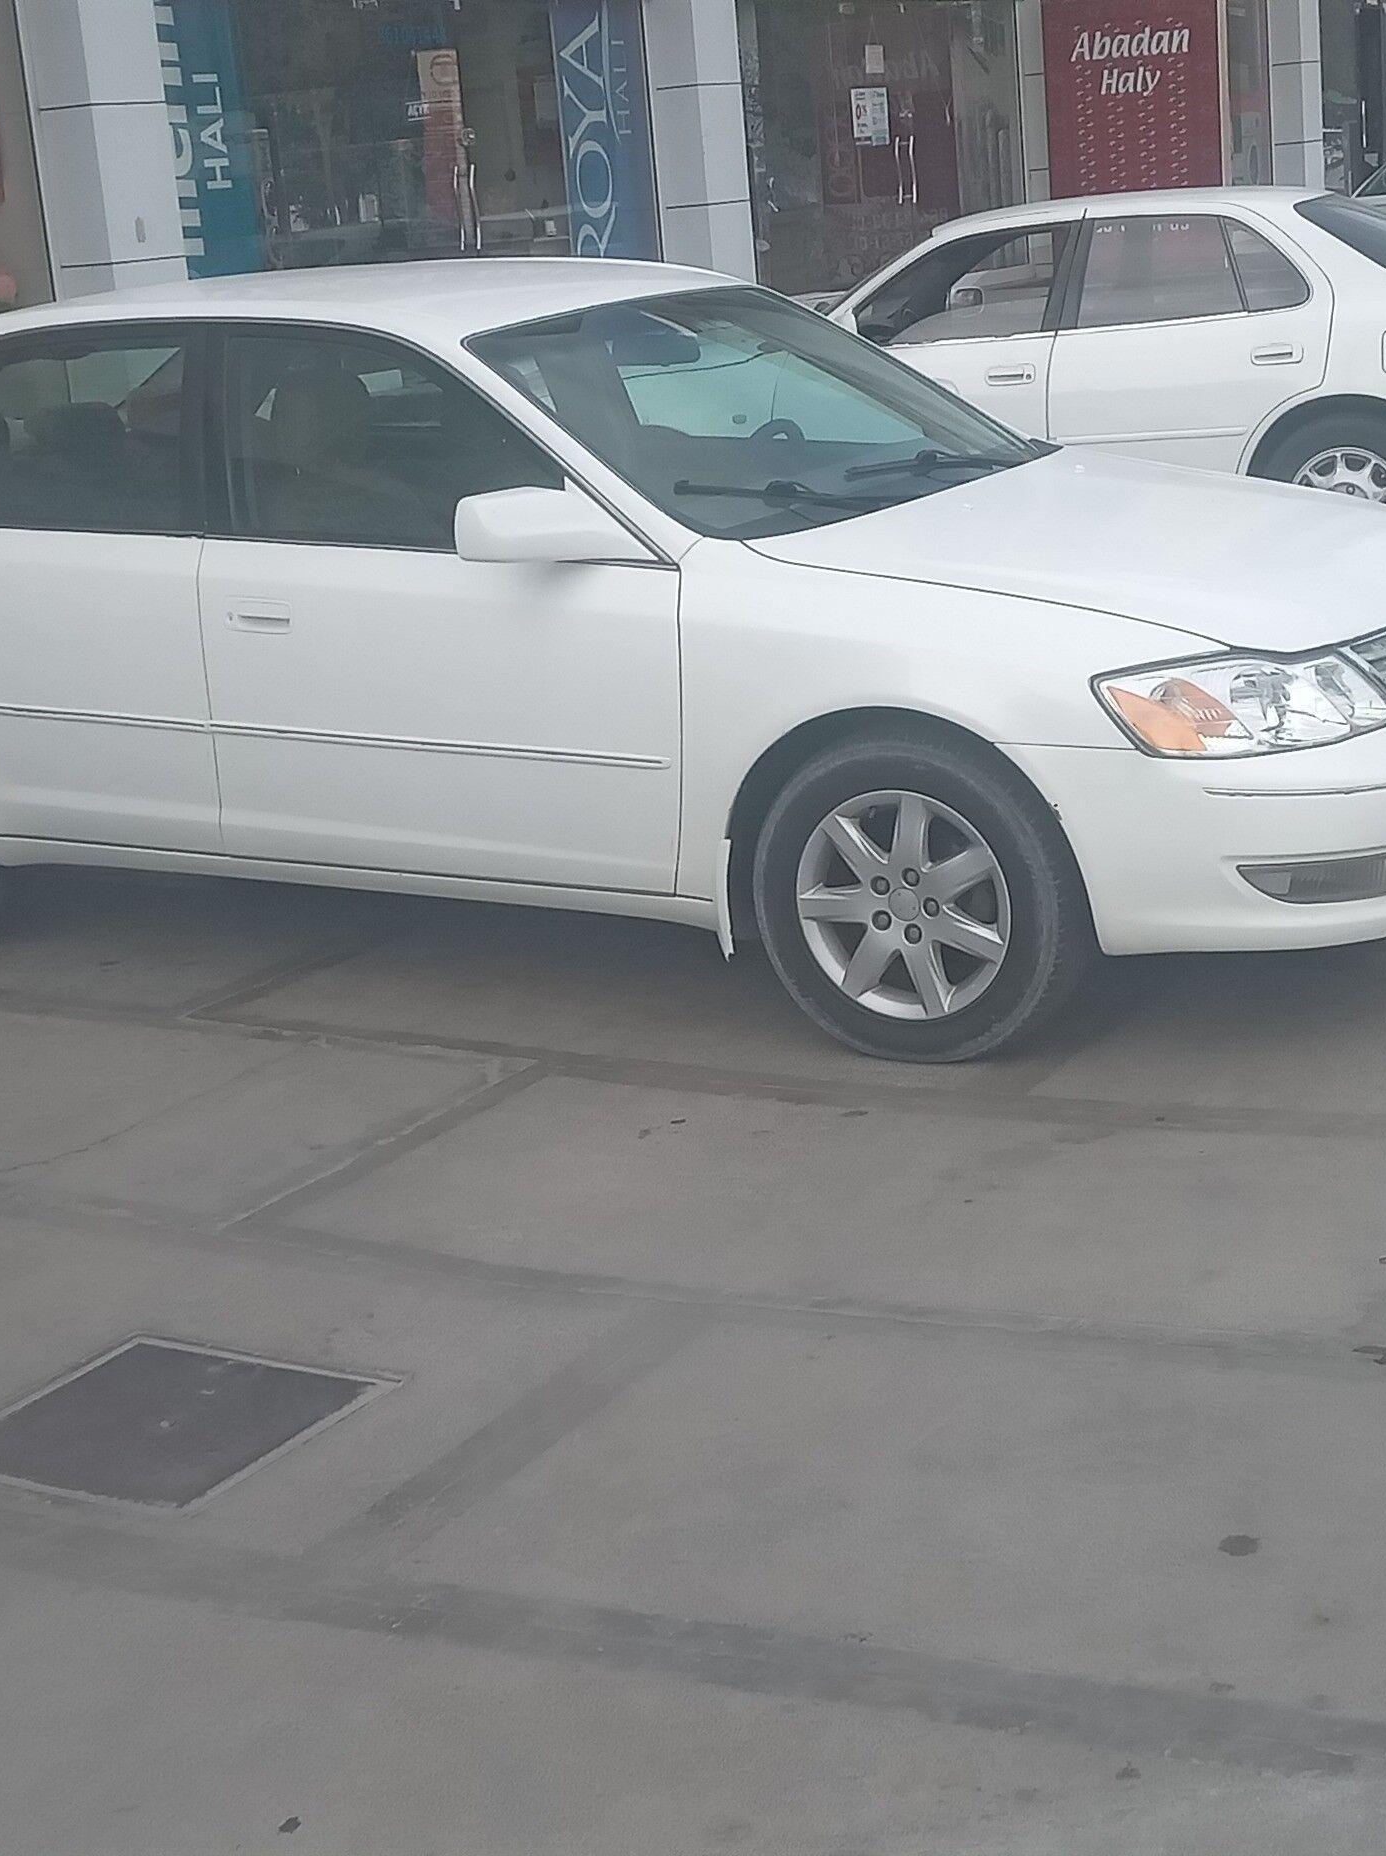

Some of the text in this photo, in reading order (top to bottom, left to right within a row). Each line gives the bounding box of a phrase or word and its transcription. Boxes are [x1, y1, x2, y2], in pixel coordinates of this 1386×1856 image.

[611, 40, 632, 135] HALI
[1070, 26, 1191, 62] Abadan
[1100, 65, 1162, 97] Haly
[192, 73, 232, 190] HALI
[559, 11, 619, 258] ROYA
